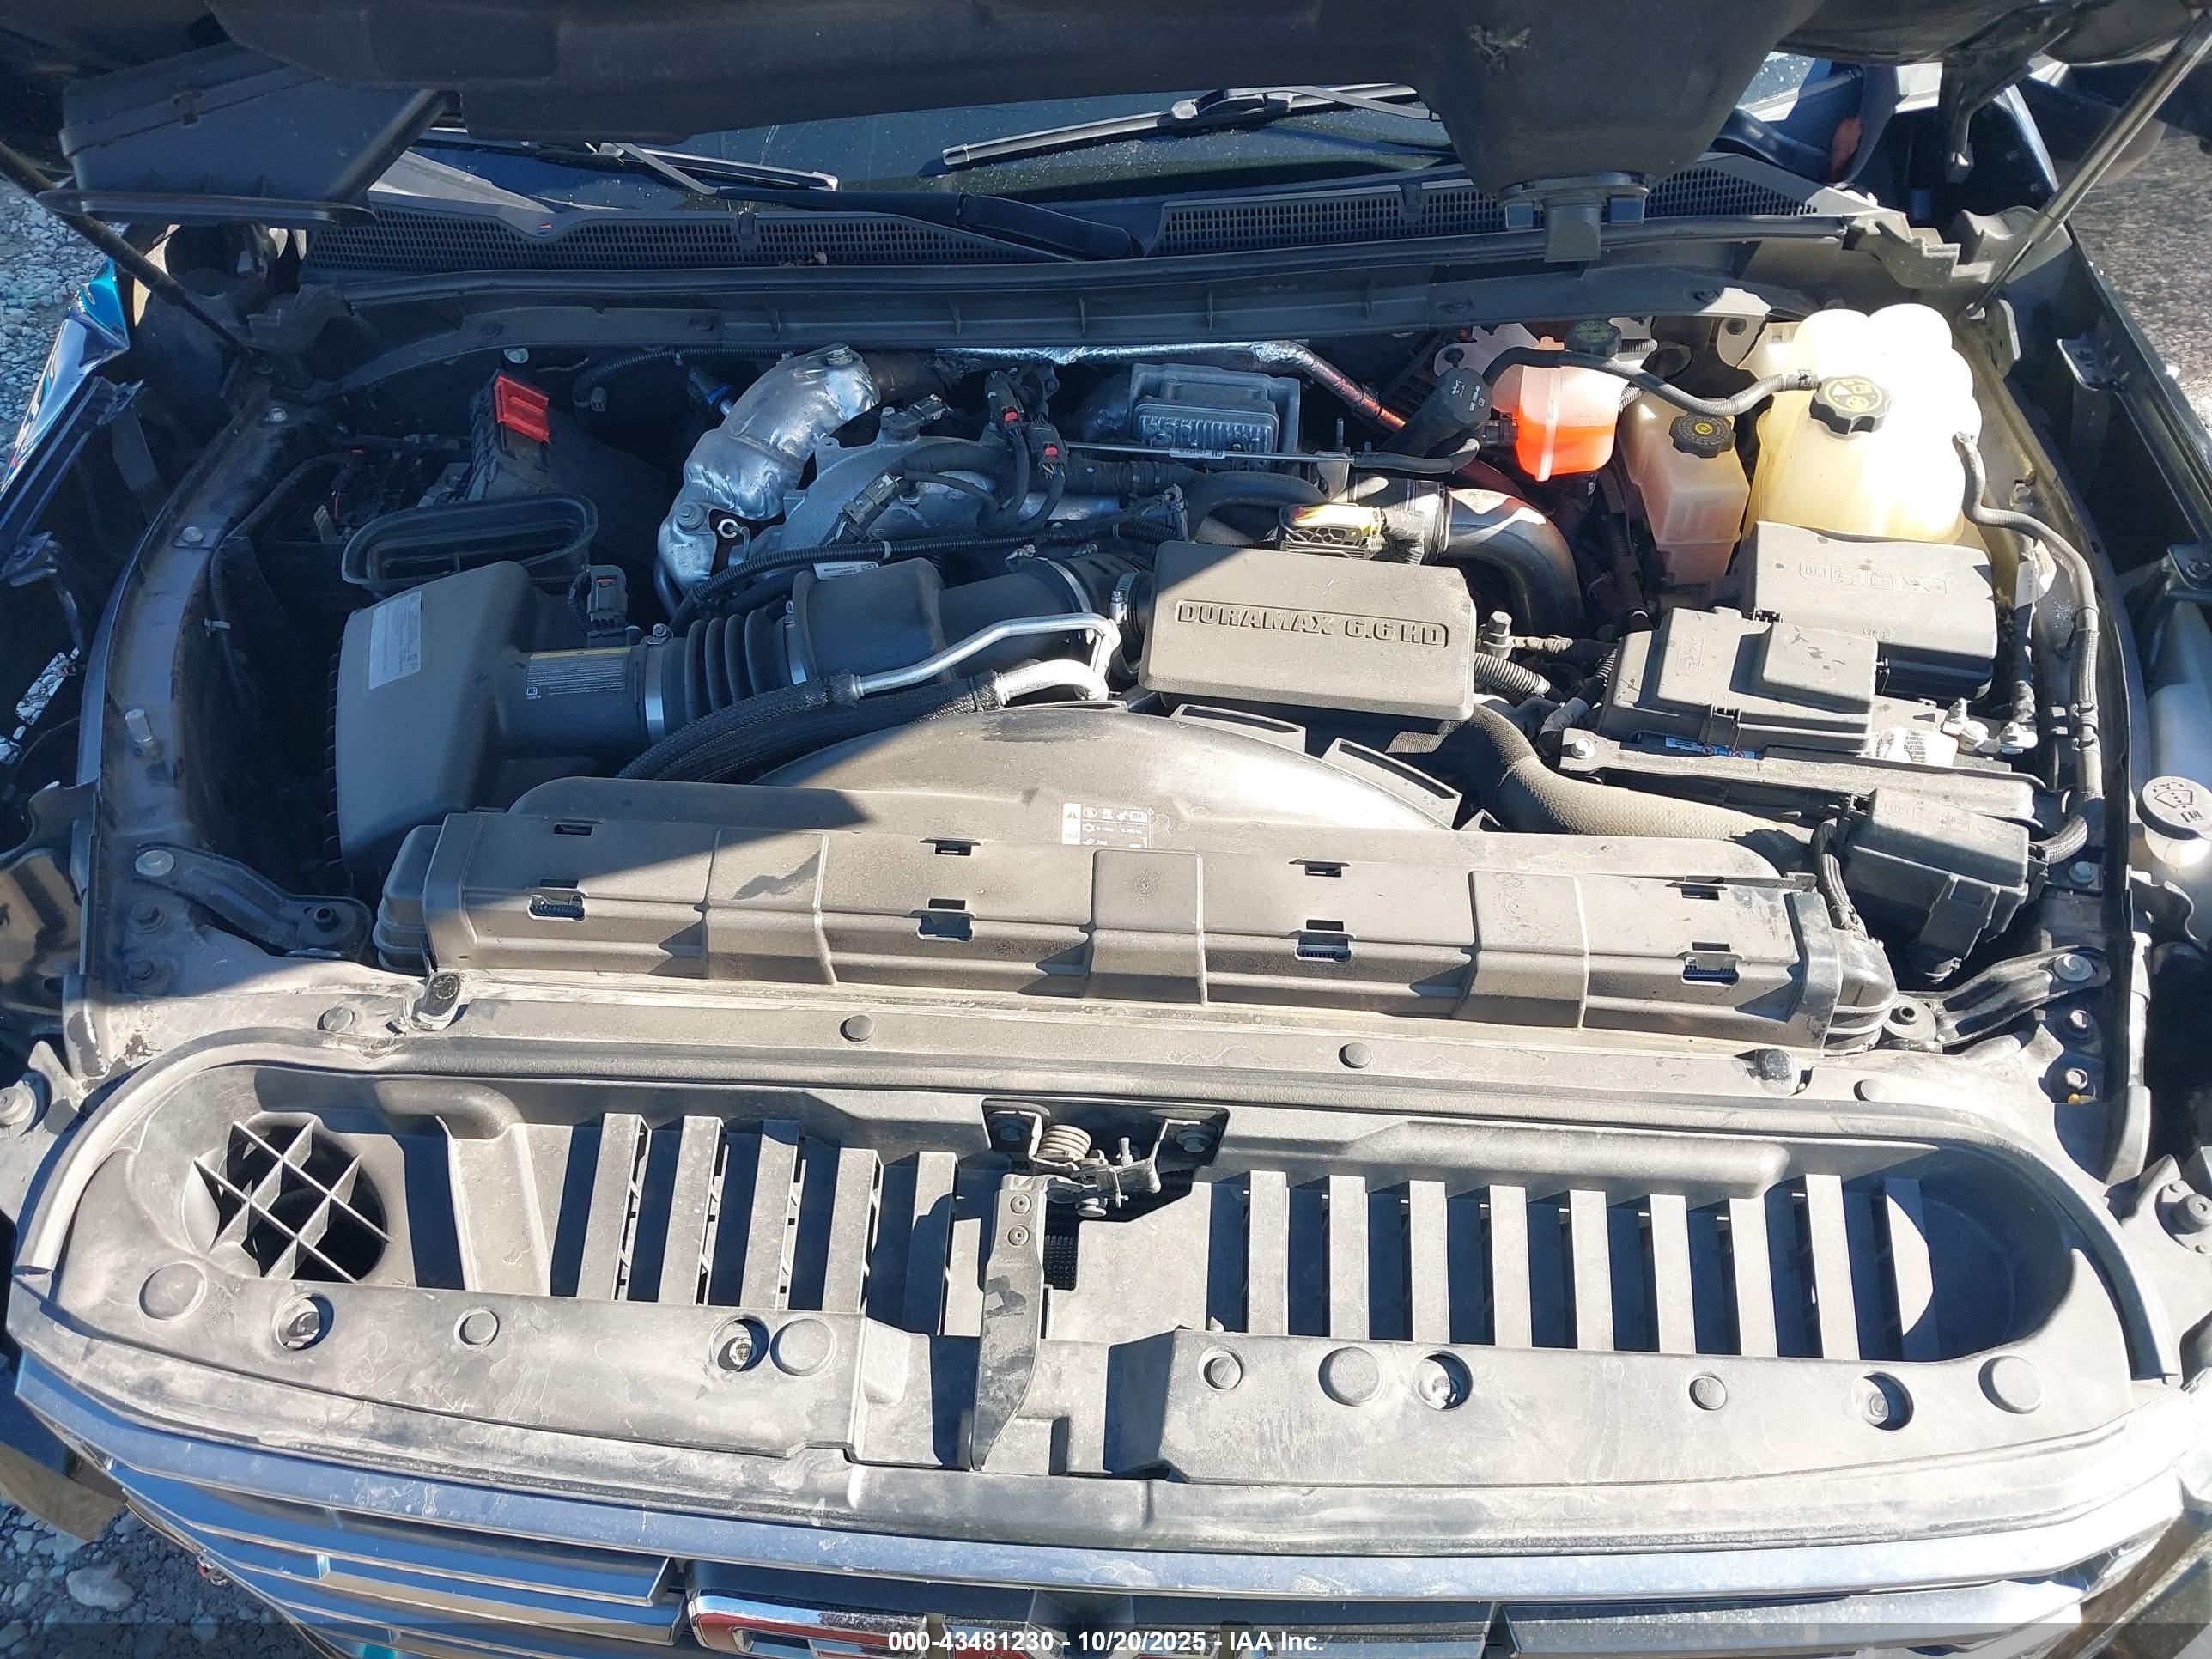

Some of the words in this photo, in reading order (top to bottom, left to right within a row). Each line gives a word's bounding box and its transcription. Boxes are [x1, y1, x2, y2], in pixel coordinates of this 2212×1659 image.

[1177, 603, 1334, 635] DURAMAX
[1345, 618, 1395, 641] 6.6
[1400, 623, 1446, 646] HD
